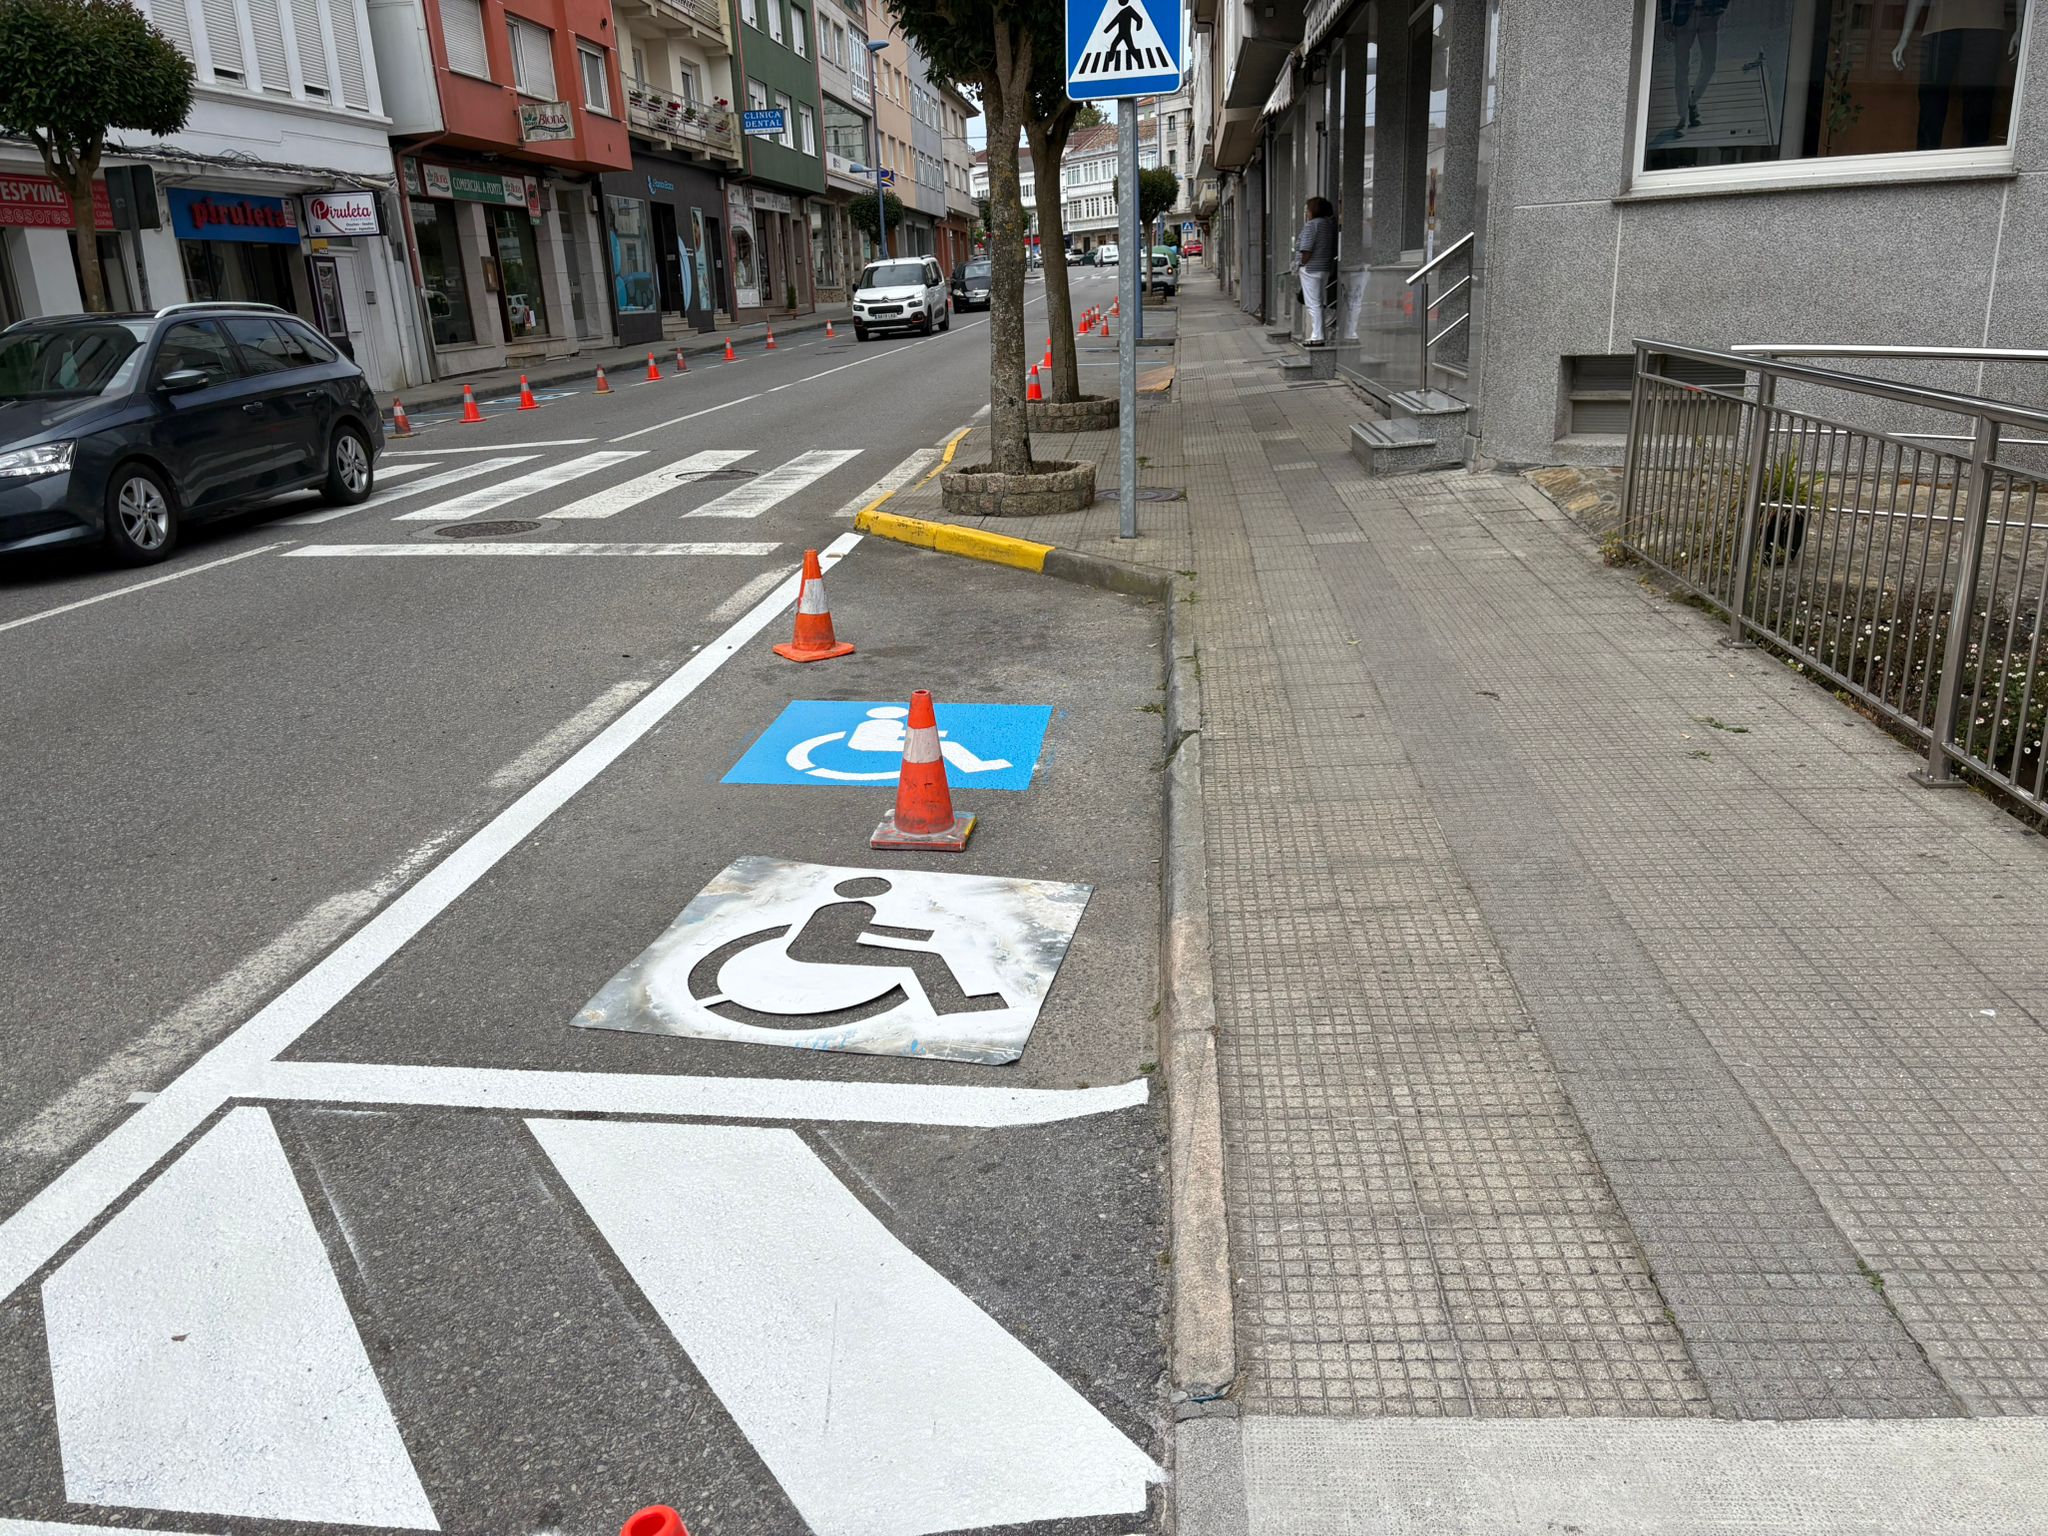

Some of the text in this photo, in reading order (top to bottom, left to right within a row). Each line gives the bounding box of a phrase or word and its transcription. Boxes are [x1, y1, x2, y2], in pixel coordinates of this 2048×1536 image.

[744, 111, 781, 120] CLINICA
[745, 120, 782, 128] DENTAL
[311, 199, 371, 219] Piruleta
